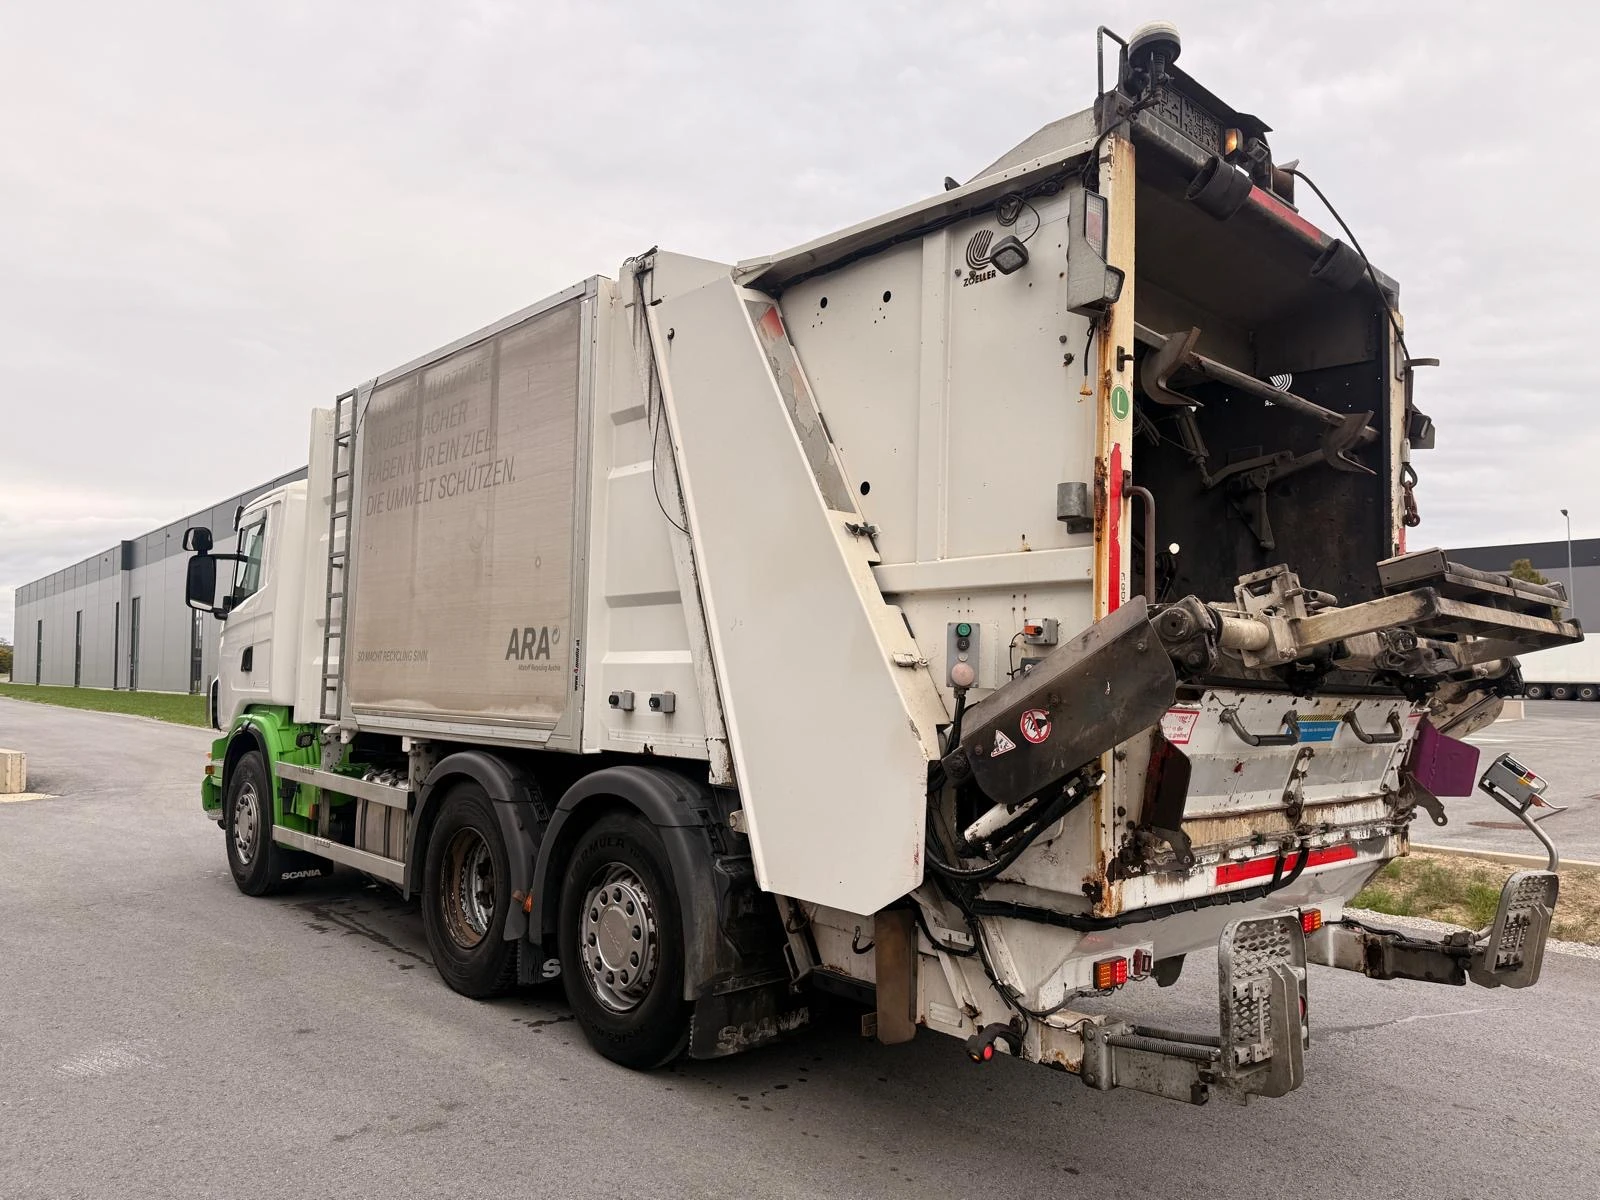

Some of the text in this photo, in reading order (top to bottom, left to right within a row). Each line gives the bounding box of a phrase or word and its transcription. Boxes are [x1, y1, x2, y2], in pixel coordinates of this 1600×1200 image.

[963, 270, 997, 287] ZOELLER
[1115, 391, 1125, 415] L
[367, 456, 405, 487] HABEN
[408, 446, 434, 474] NUR
[437, 438, 460, 466] EIN
[366, 456, 516, 517] DIE UMWELT SCHÜTZEN.
[505, 626, 551, 660] ARA
[281, 869, 322, 880] SCANIA
